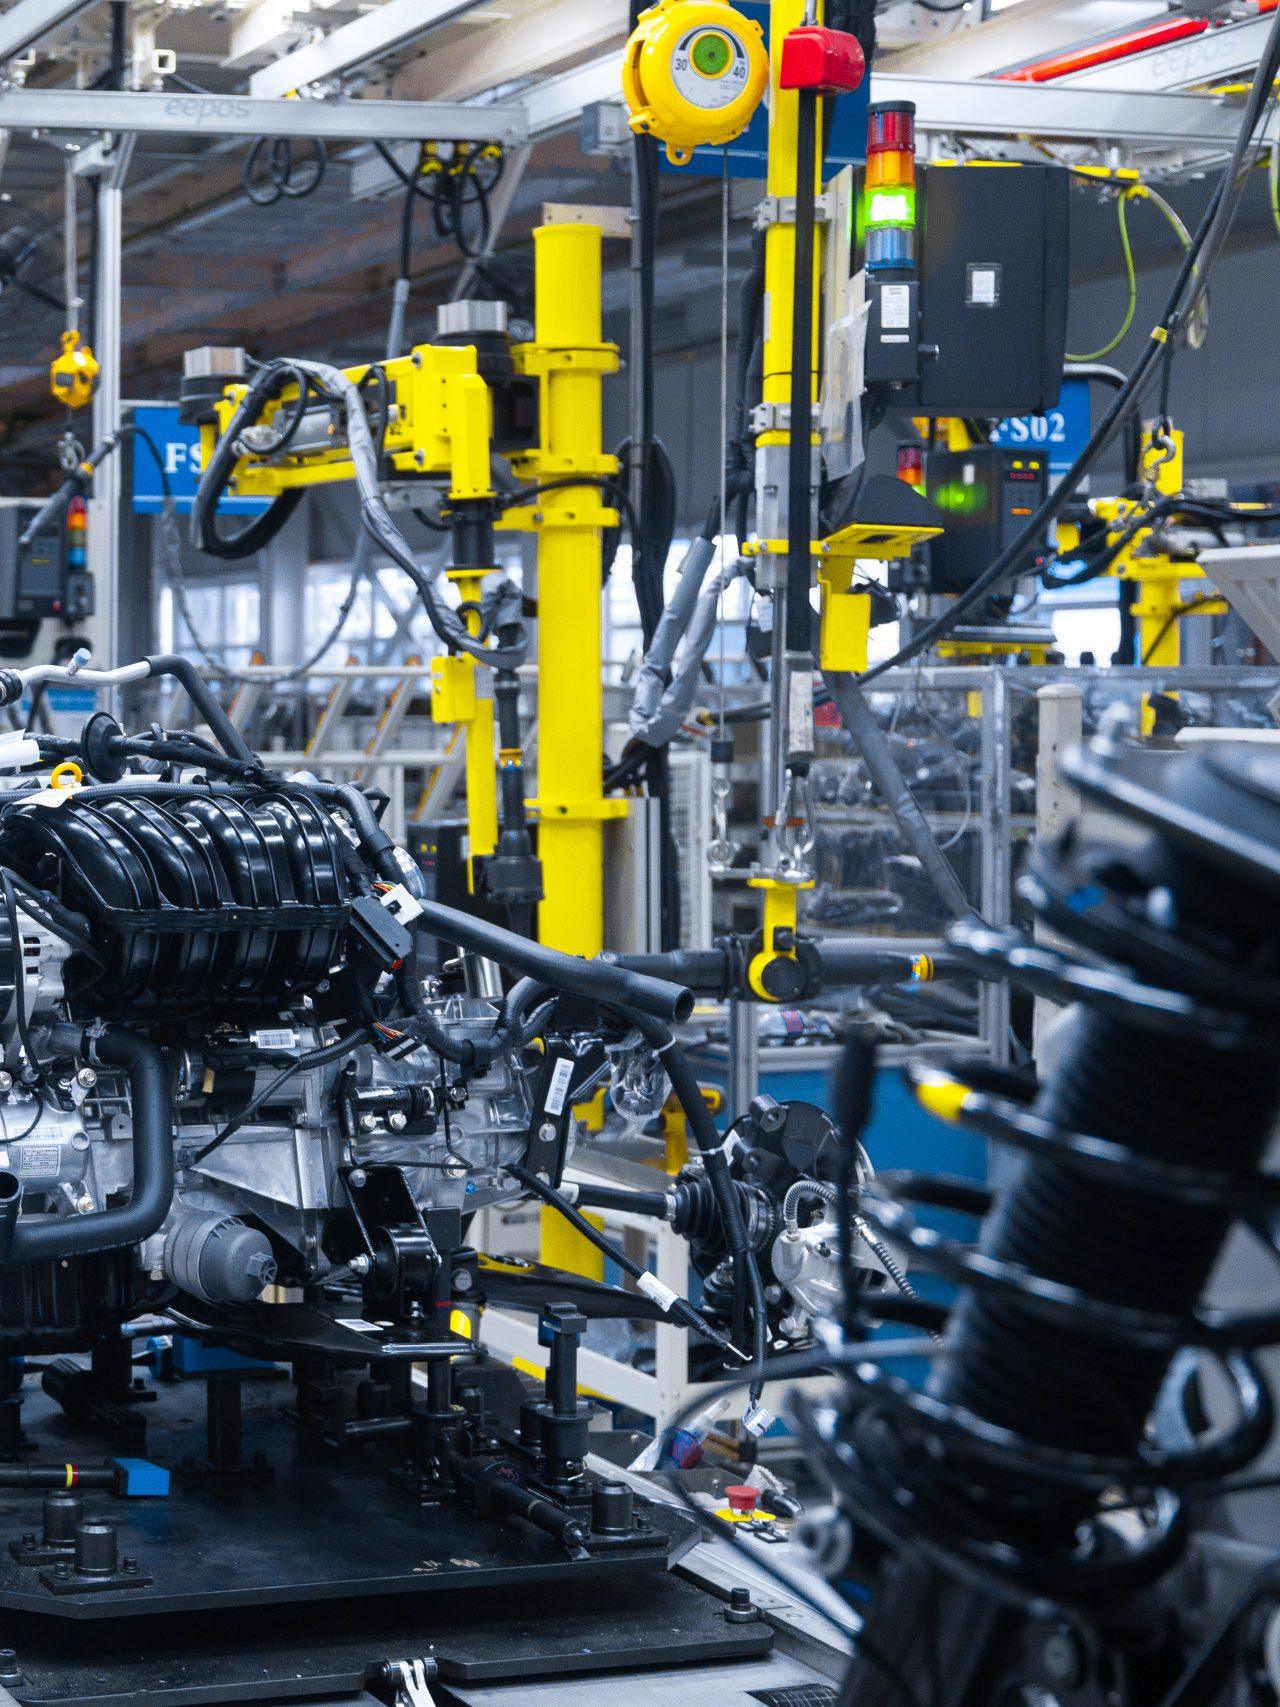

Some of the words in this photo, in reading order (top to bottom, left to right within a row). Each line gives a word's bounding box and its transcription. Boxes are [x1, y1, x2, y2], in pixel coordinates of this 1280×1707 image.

[675, 58, 688, 71] 30
[733, 66, 746, 79] 40
[164, 98, 250, 124] eepos
